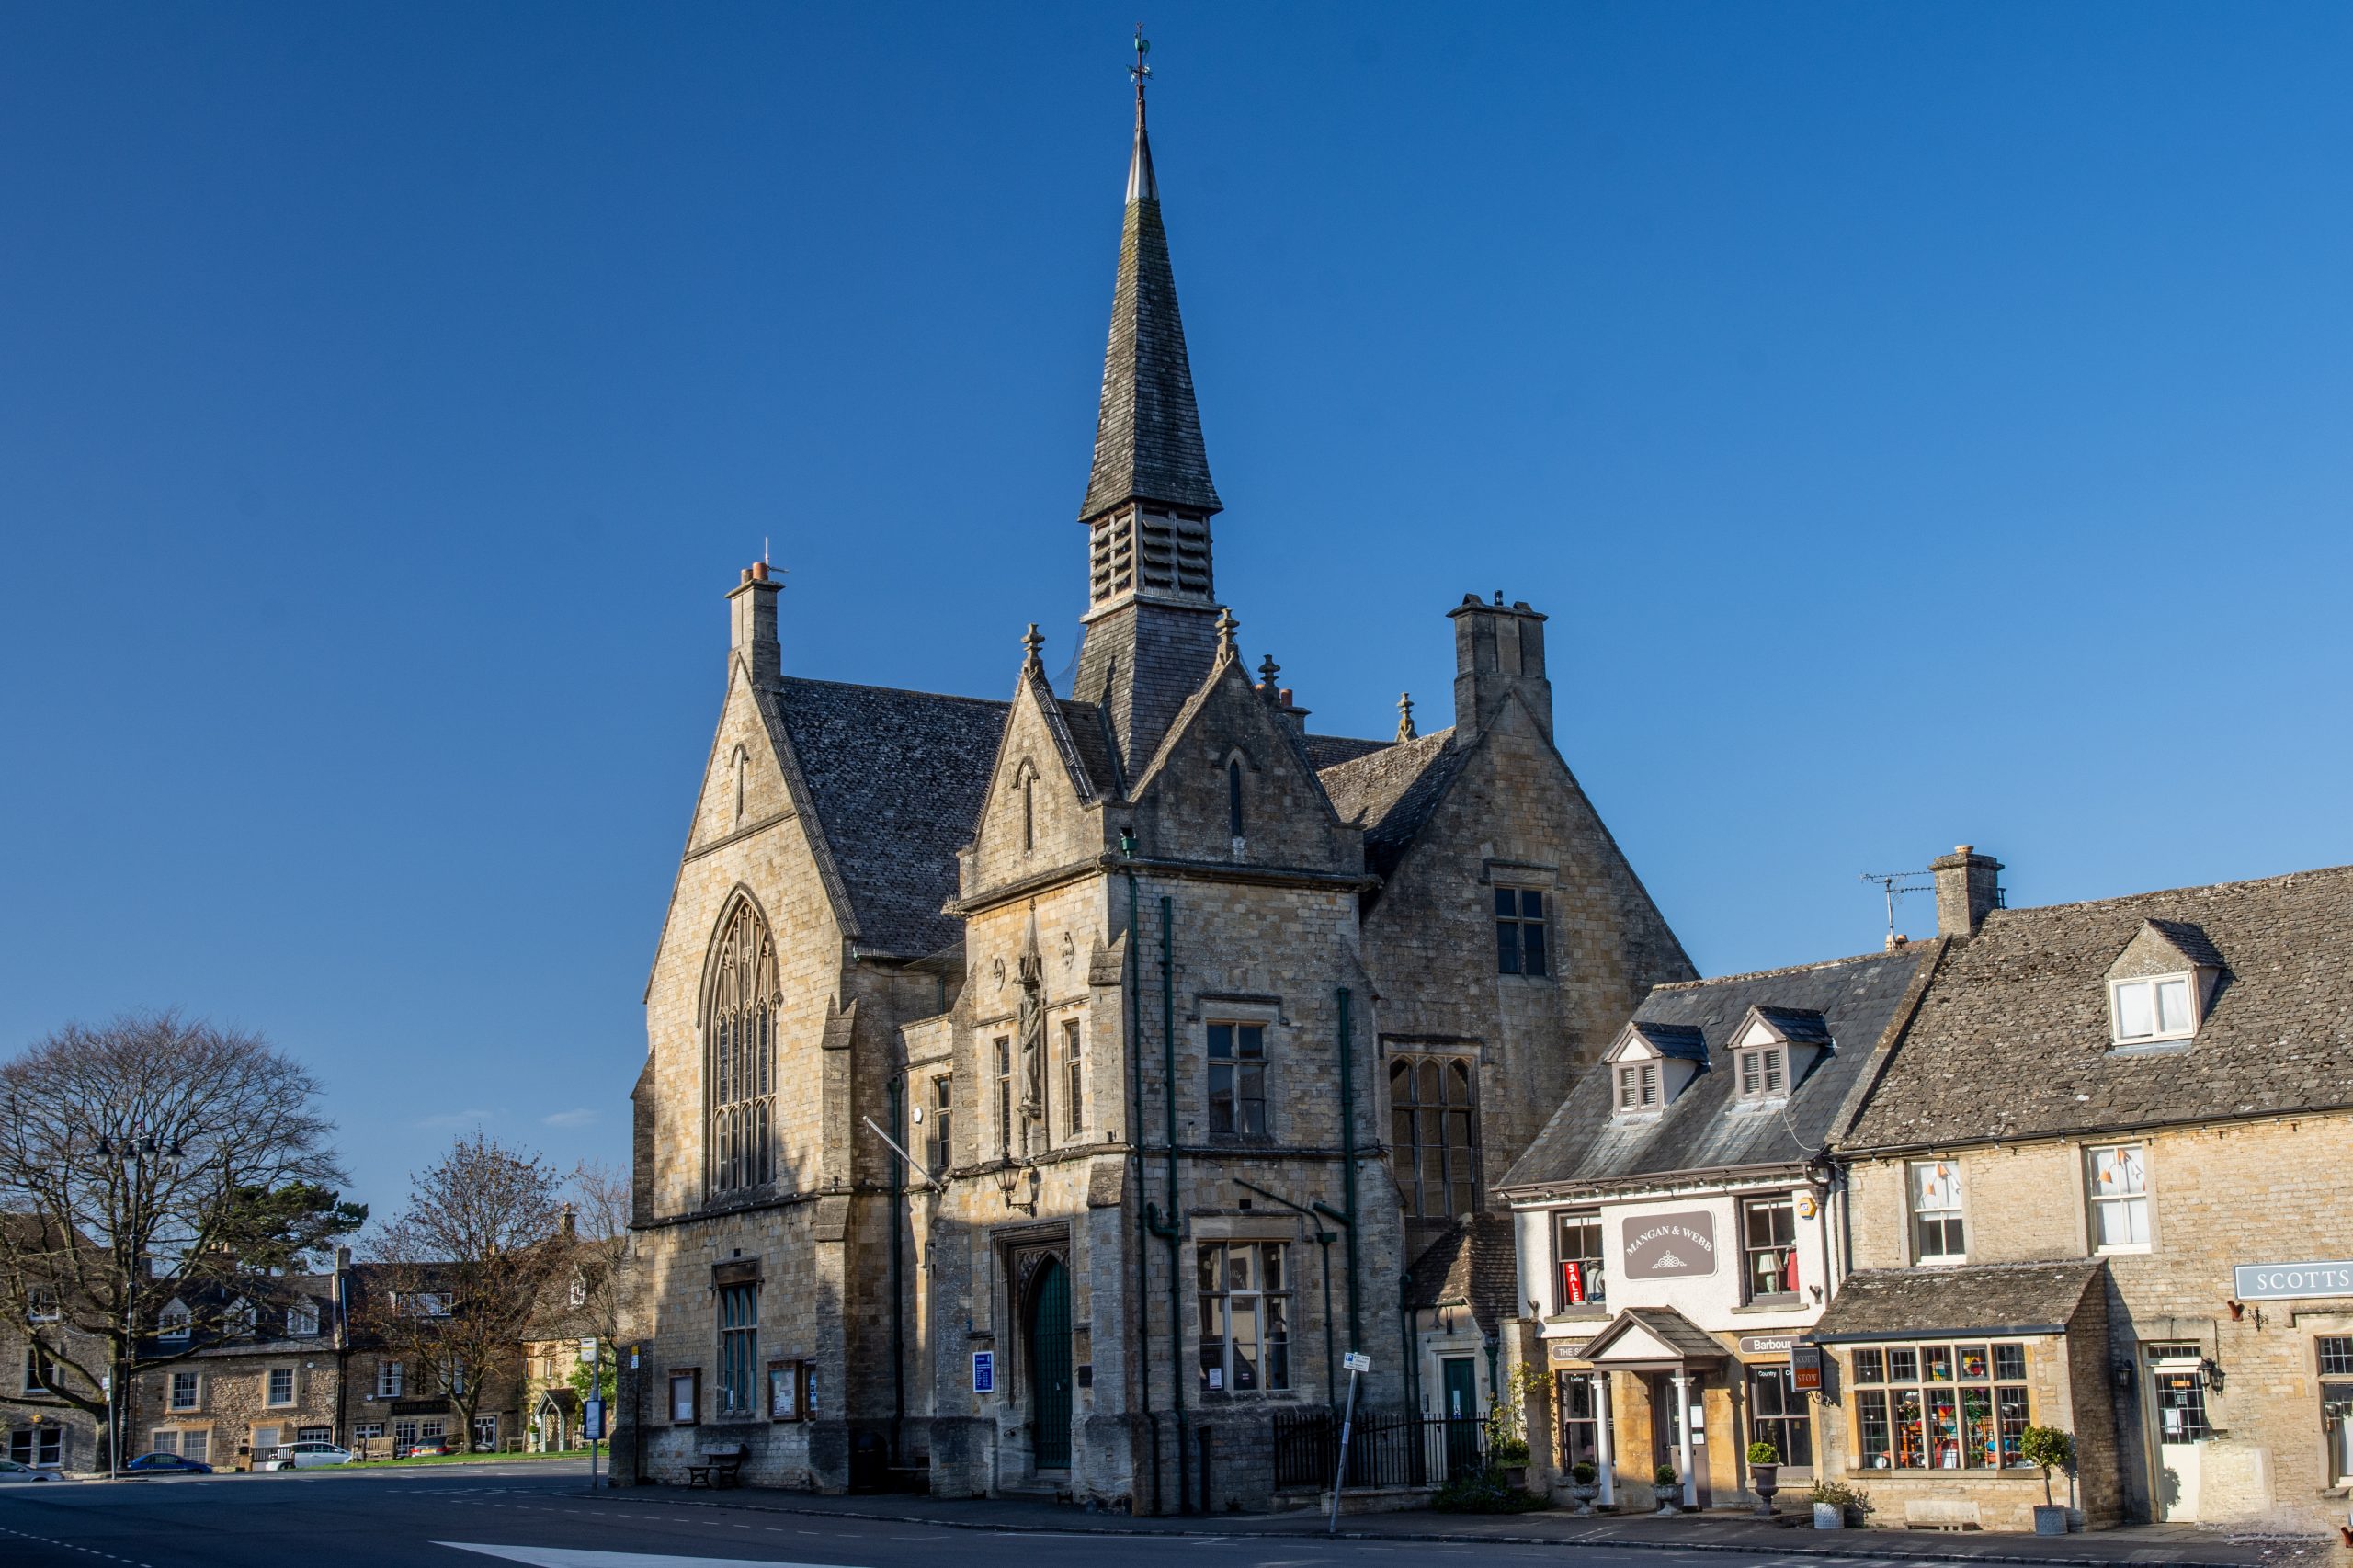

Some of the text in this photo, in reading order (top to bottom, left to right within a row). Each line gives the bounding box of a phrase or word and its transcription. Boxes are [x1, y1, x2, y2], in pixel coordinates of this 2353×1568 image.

[1626, 1225, 1712, 1256] MANGAN & WEBB
[1568, 1264, 1580, 1301] SALE
[2257, 1269, 2349, 1290] SCOTTS
[1754, 1339, 1791, 1350] Barbour
[1559, 1348, 1573, 1357] THE
[1794, 1355, 1817, 1364] SCOTTS
[1797, 1373, 1817, 1382] STOW
